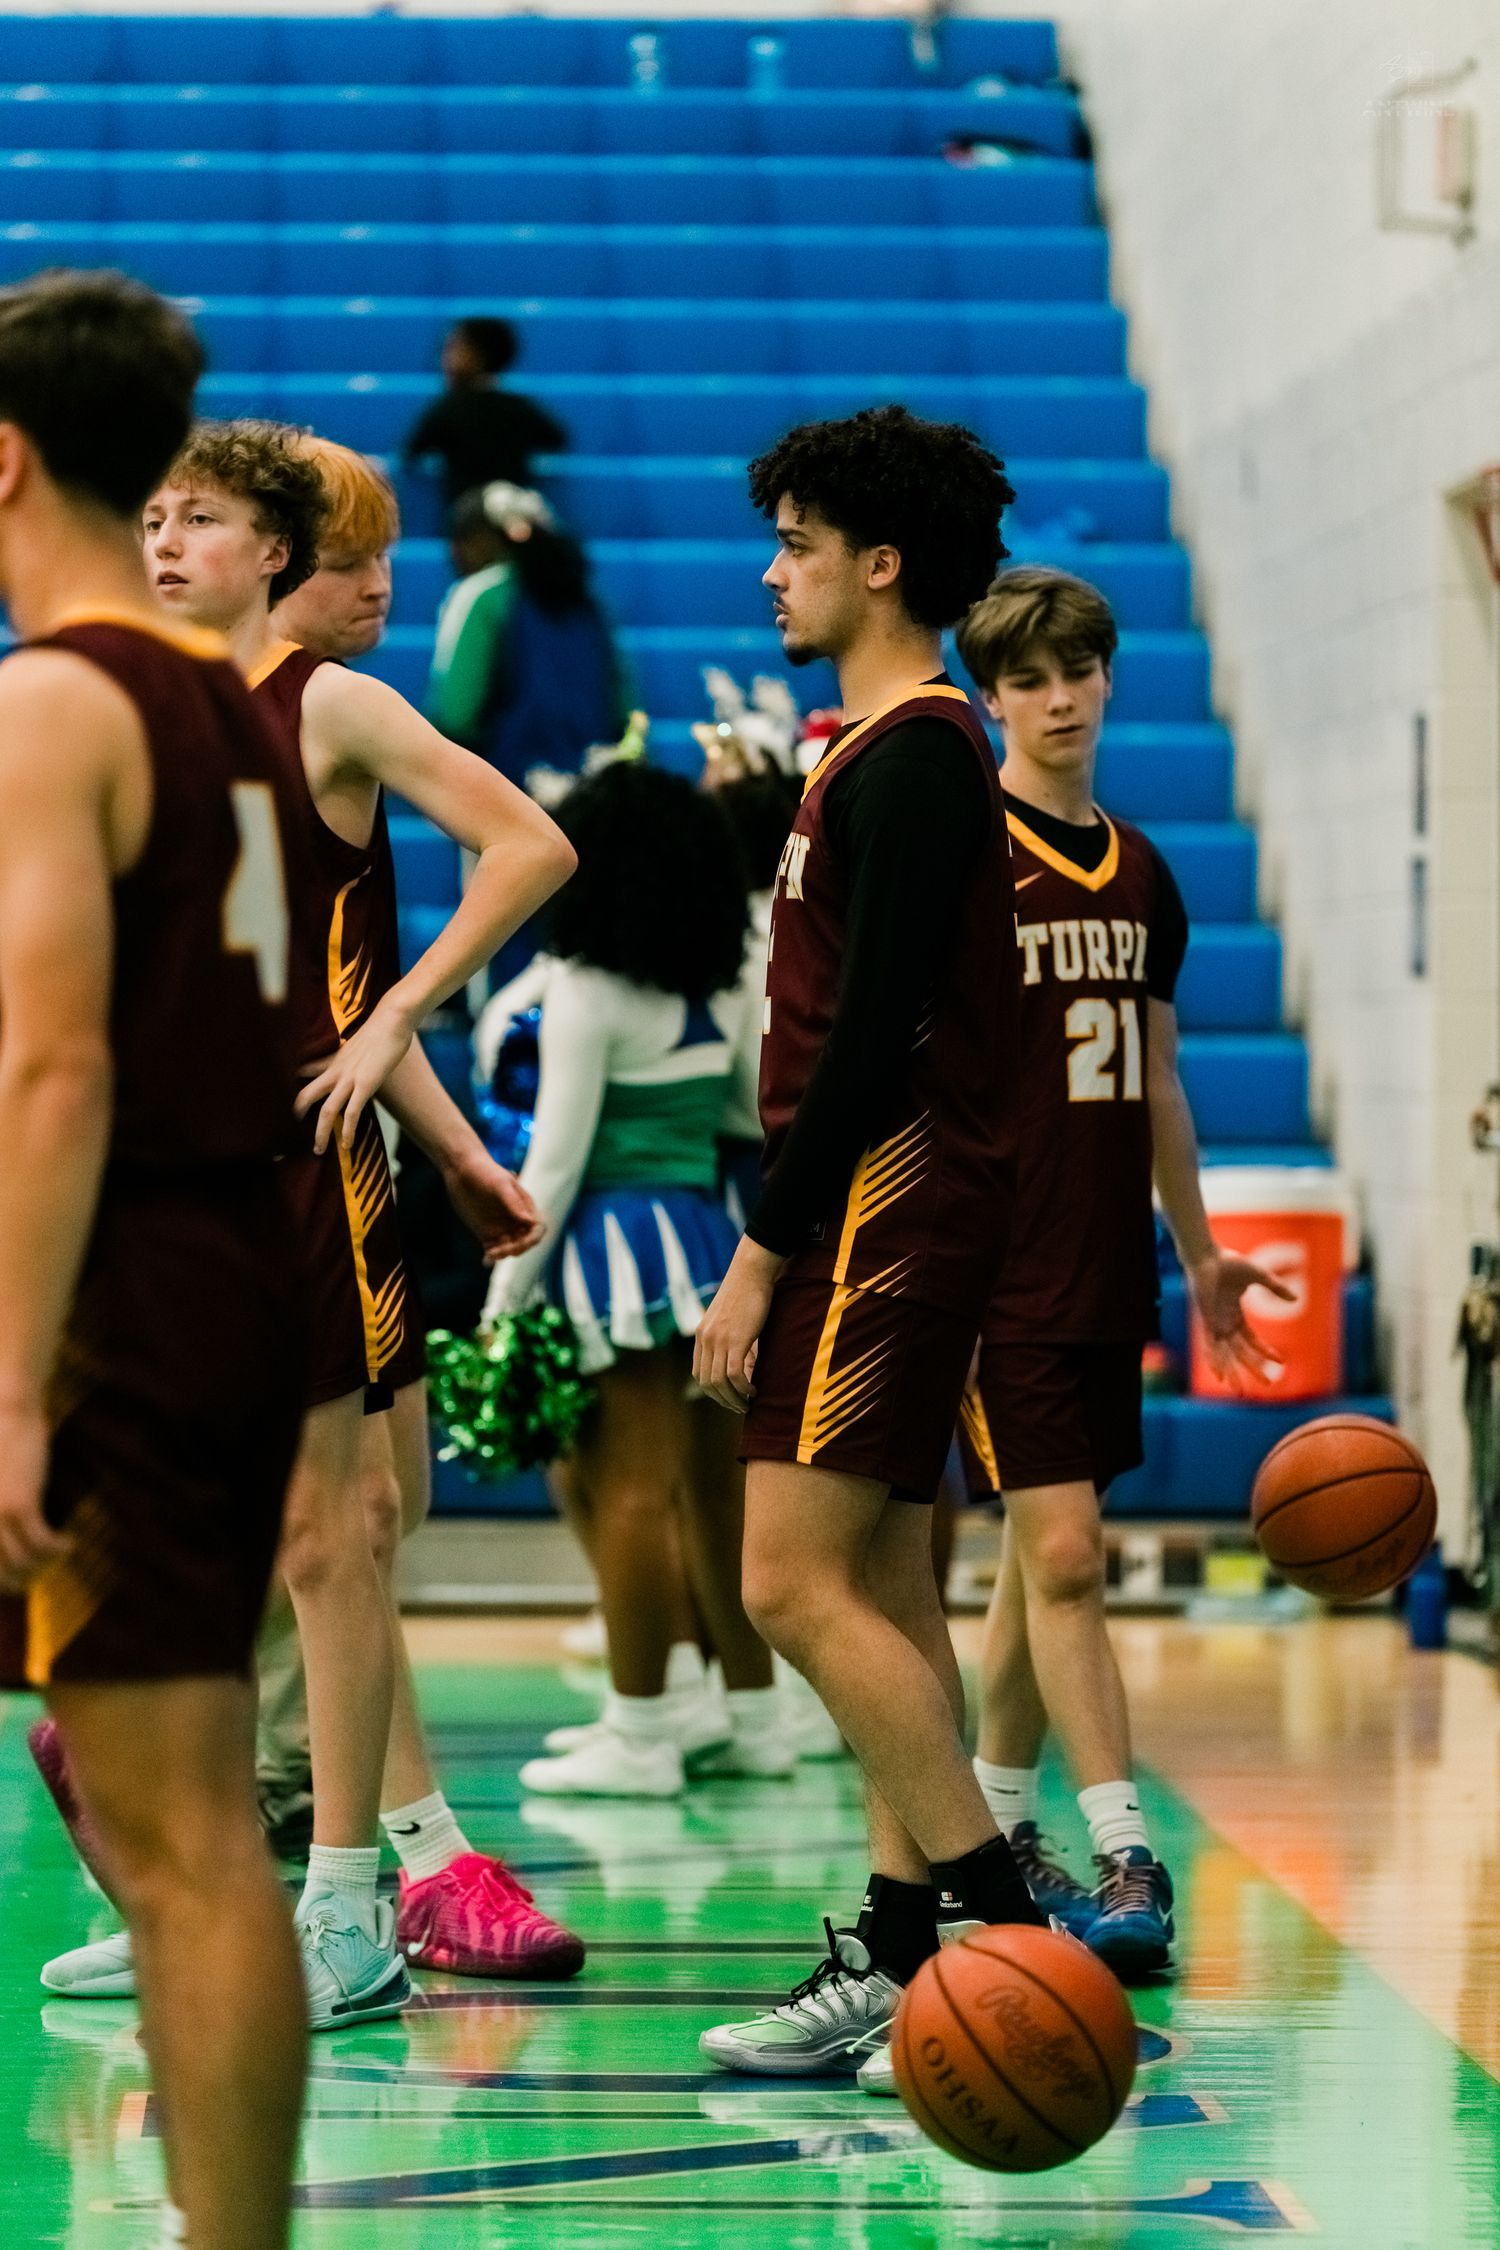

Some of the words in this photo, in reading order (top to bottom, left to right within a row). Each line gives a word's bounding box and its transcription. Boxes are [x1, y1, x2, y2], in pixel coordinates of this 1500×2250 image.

[1016, 919, 1148, 986] TURPI
[1065, 998, 1143, 1102] 21
[921, 2036, 1020, 2154] OHSAA
